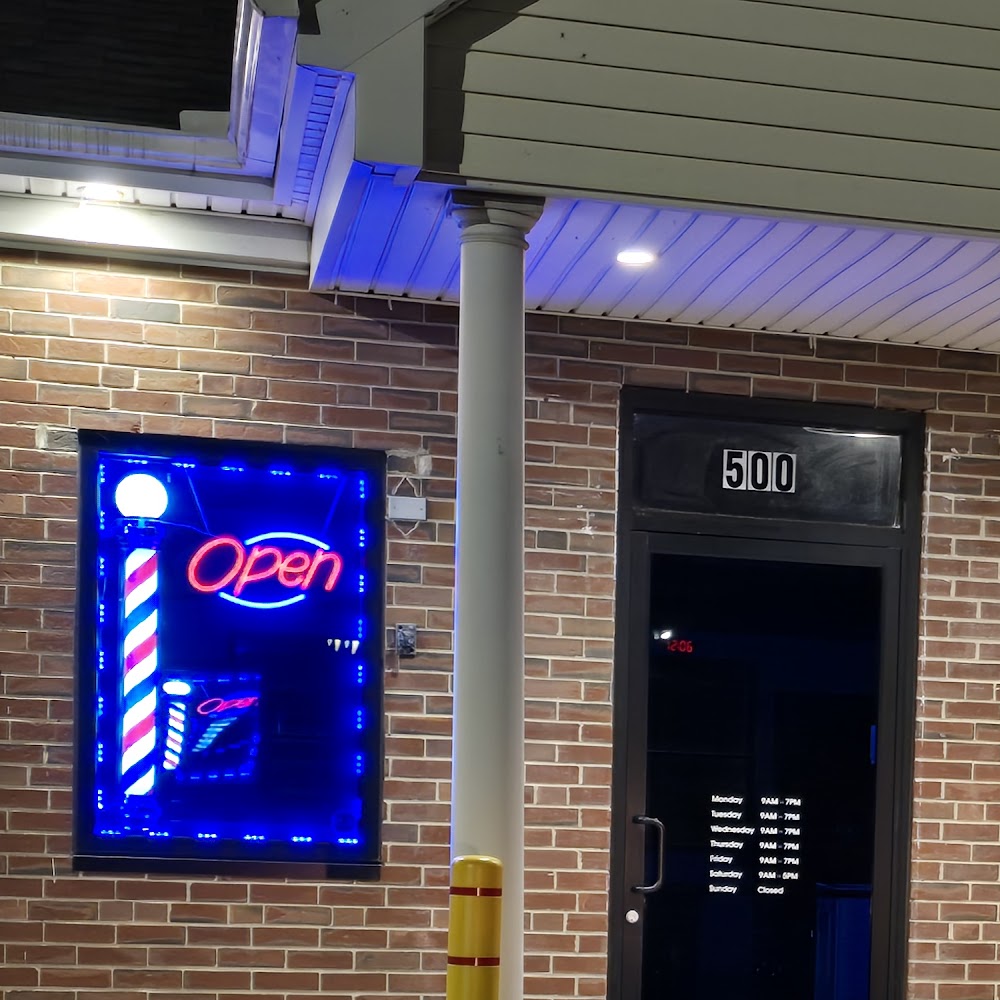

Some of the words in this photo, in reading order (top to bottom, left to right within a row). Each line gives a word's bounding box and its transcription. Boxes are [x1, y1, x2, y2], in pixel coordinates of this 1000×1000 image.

[724, 452, 794, 492] 500
[188, 536, 343, 596] Open
[712, 795, 743, 804] Monday
[761, 797, 778, 805] 9AM
[785, 798, 801, 806] 7PM
[711, 810, 742, 819] Tuesday
[760, 812, 777, 820] 9AM
[711, 825, 755, 835] Wednesday
[710, 840, 743, 849] Thursday
[784, 842, 799, 850] 7PM
[710, 855, 733, 864] Friday
[784, 857, 799, 865] 7PM
[710, 870, 743, 879] Saturday
[709, 885, 737, 893] Sunday
[757, 886, 784, 894] Closed
